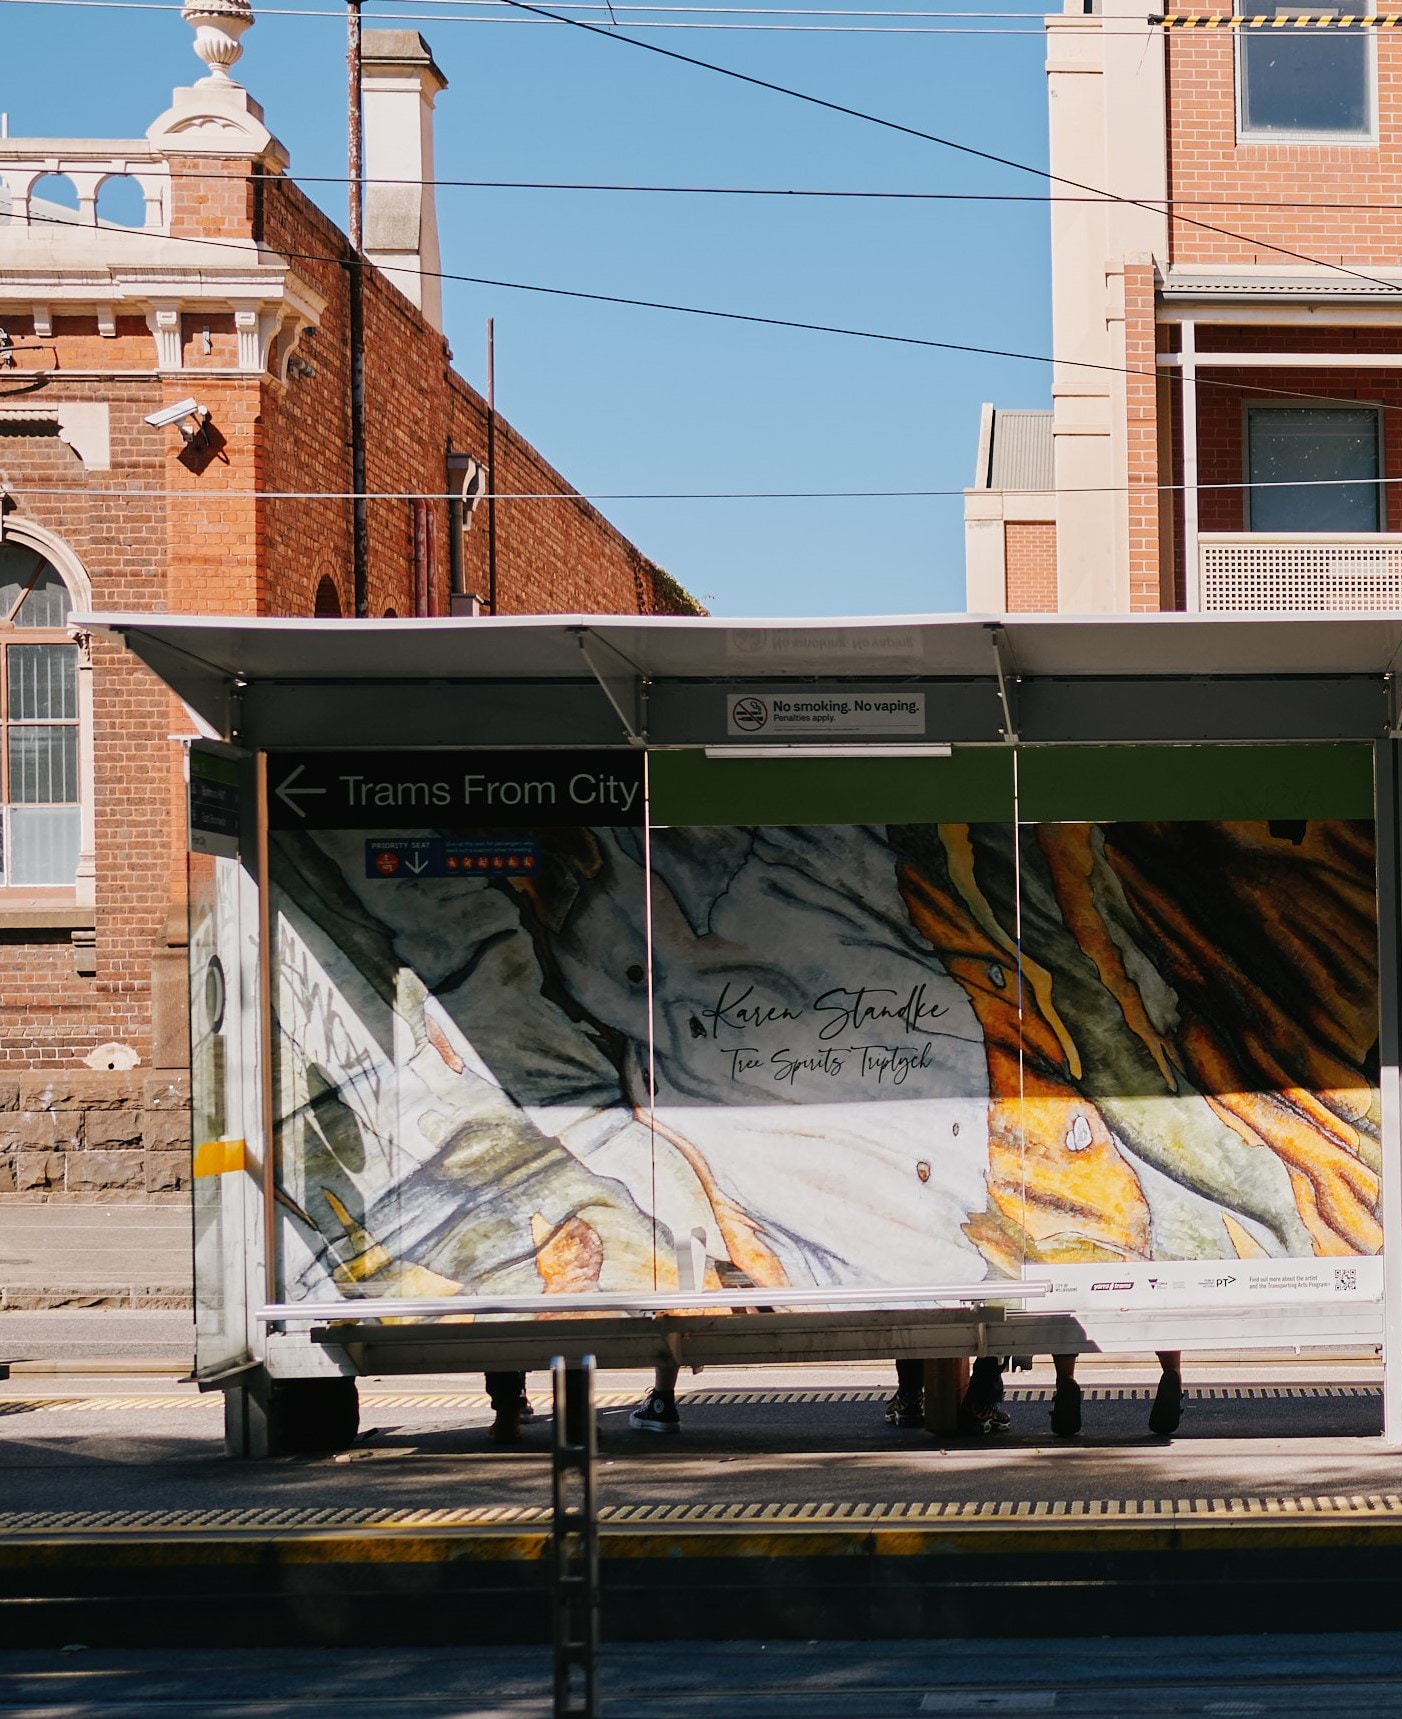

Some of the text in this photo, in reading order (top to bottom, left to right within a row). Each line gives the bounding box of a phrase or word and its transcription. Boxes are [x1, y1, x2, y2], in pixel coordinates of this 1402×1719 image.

[773, 700, 920, 714] No smoking. No vaping.
[774, 714, 836, 723] Penalties apply.
[340, 773, 640, 812] Trams From City
[702, 982, 949, 1041] Karen Standke
[721, 1042, 935, 1086] Tree Spirits Triptych
